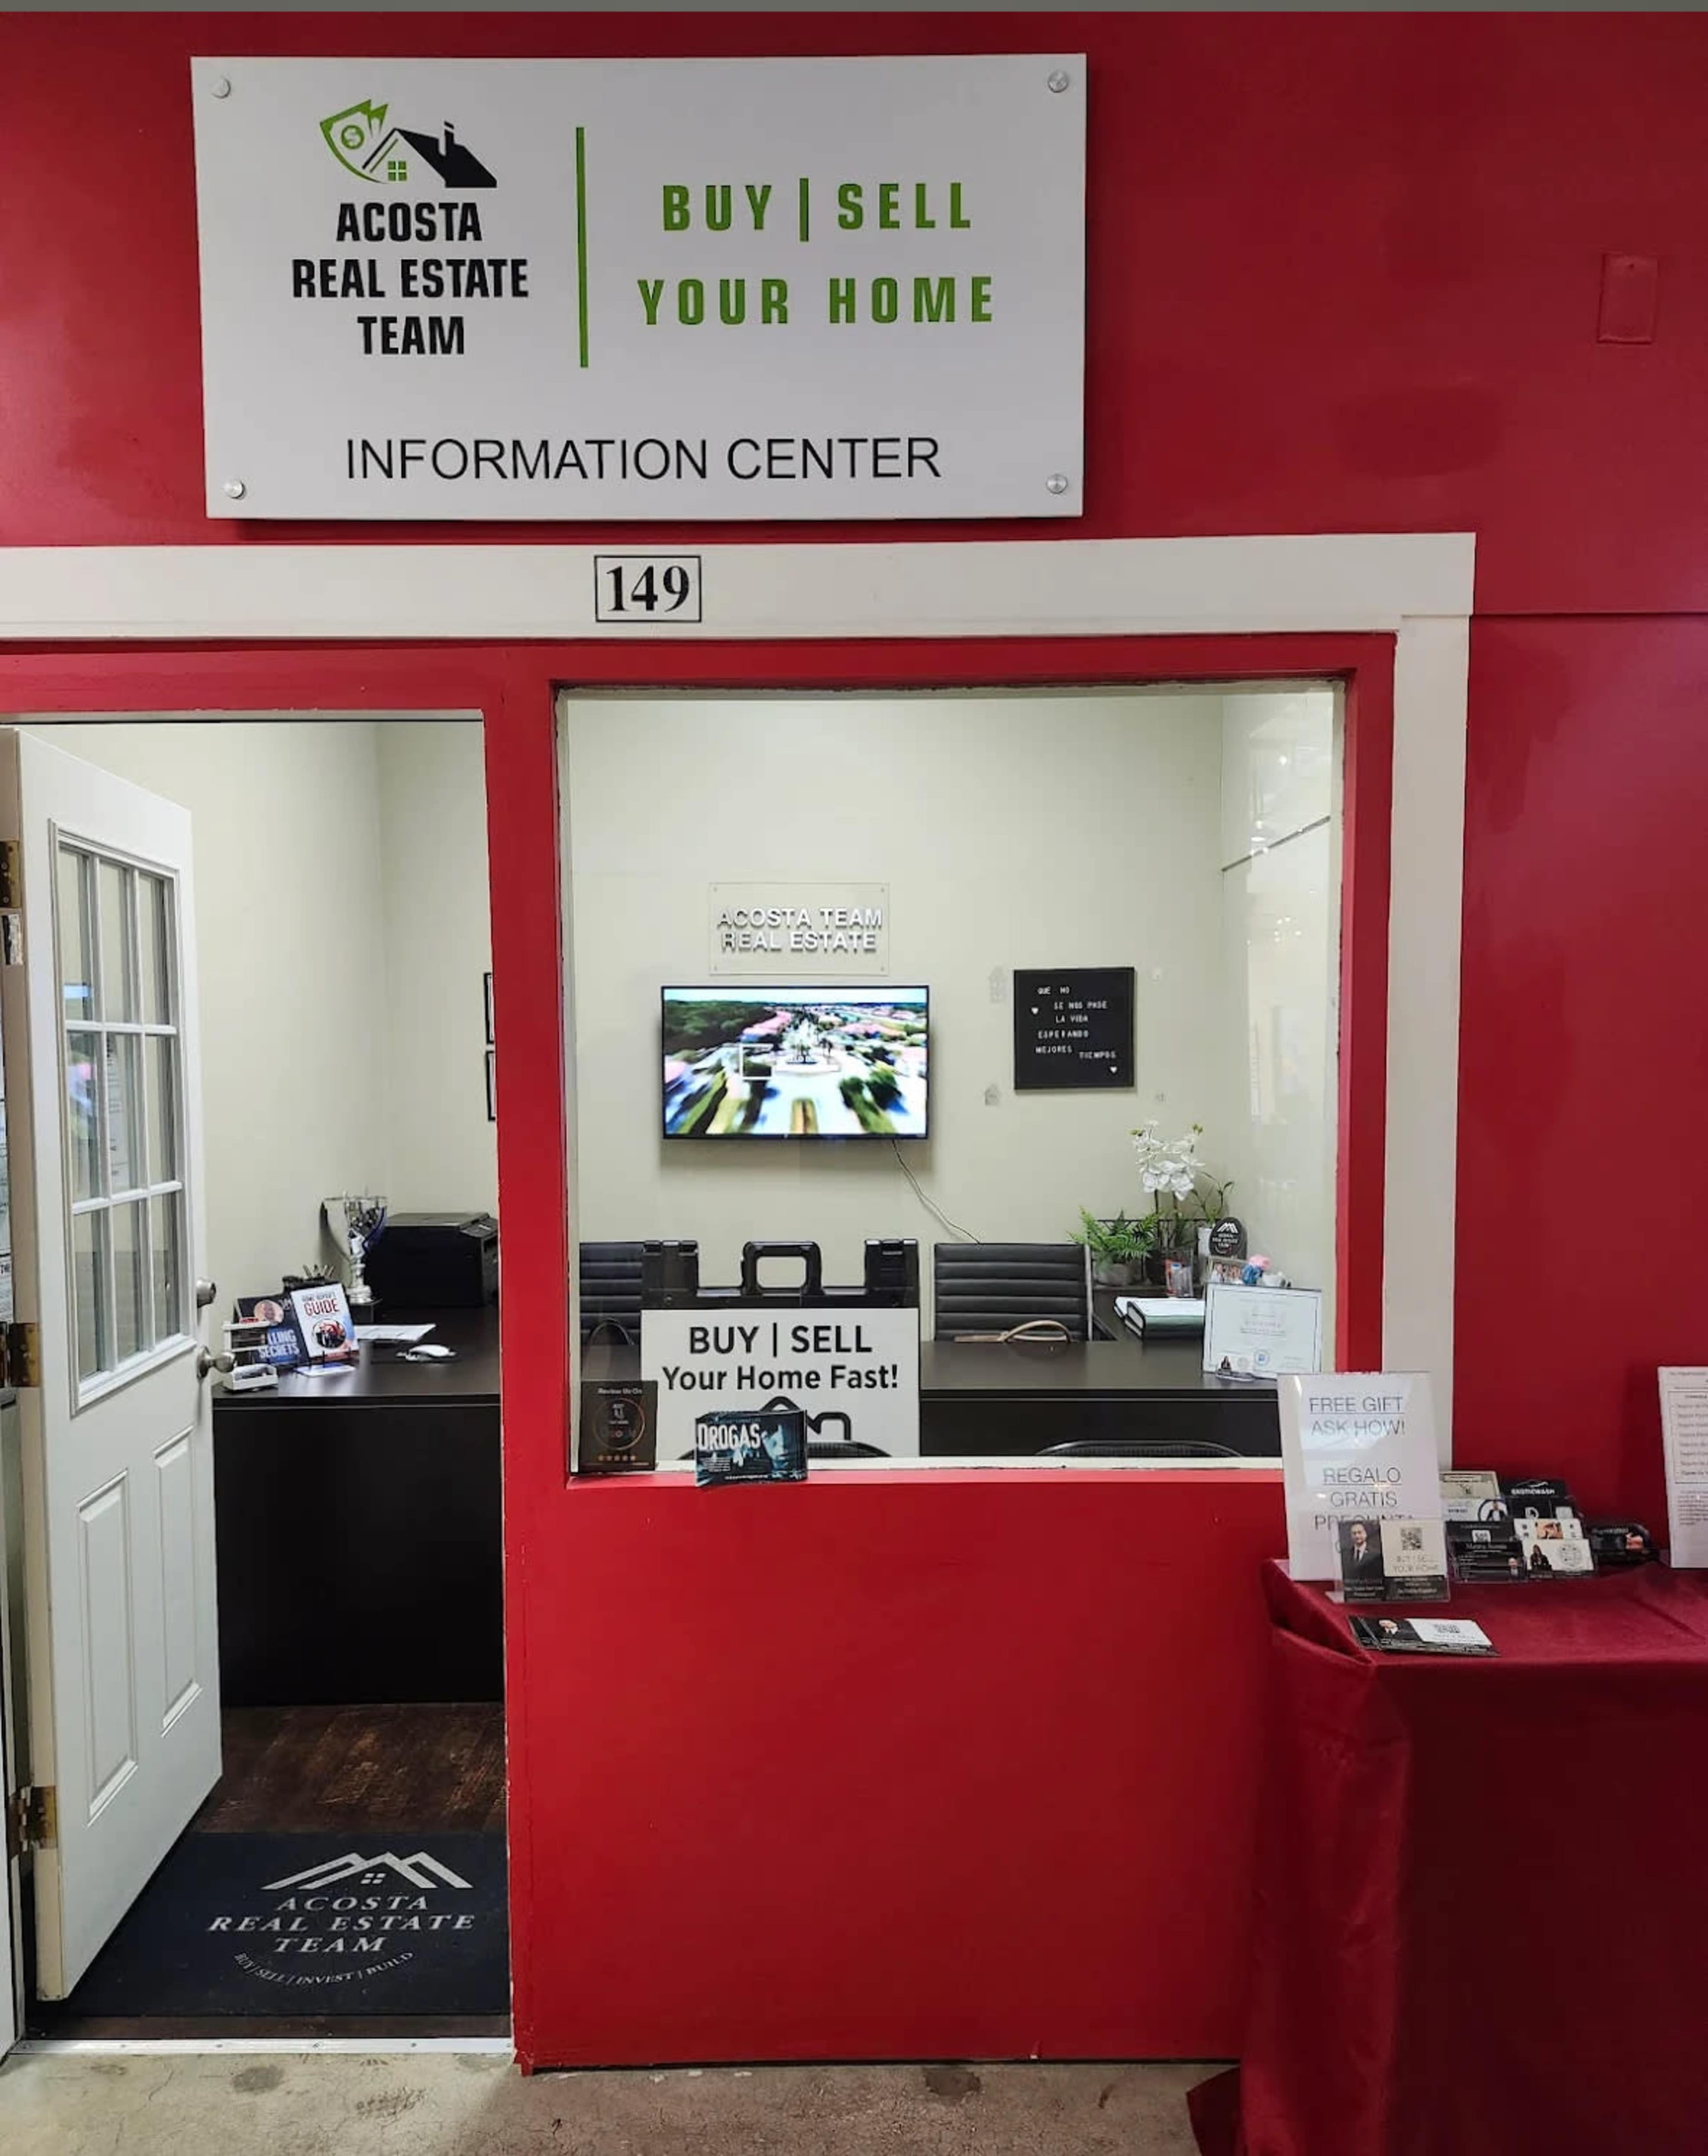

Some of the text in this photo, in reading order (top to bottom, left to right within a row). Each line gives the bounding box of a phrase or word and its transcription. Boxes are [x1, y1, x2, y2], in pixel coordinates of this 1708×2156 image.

[663, 185, 772, 231] BUY
[838, 183, 971, 230] SELL
[337, 203, 482, 241] ACOSTA
[293, 259, 528, 297] REAL ESTATE
[637, 277, 991, 325] YOUR HOME
[357, 317, 464, 354] TEAM
[348, 437, 941, 480] INFORMATION CENTER
[606, 565, 689, 612] 149
[717, 908, 882, 928] ACOSTA TEAM
[722, 932, 876, 951] REAL ESTATE
[1038, 1030, 1089, 1039] ESPERANDO
[1035, 1045, 1072, 1054] MEJORES
[304, 1298, 338, 1316] GUIDE
[689, 1326, 759, 1354] BUY
[791, 1325, 872, 1353] SELL
[662, 1364, 898, 1390] Your Home Fast!
[1309, 1397, 1403, 1412] FREE GIFT
[698, 1424, 761, 1450] DROGAS
[1312, 1419, 1405, 1436] ASK HOW!
[1323, 1467, 1402, 1483] REGALO
[1330, 1492, 1397, 1507] GRATIS
[277, 1896, 428, 1911] ACOSTA
[208, 1914, 476, 1932] REAL ESTATE
[274, 1937, 388, 1953] TEAM
